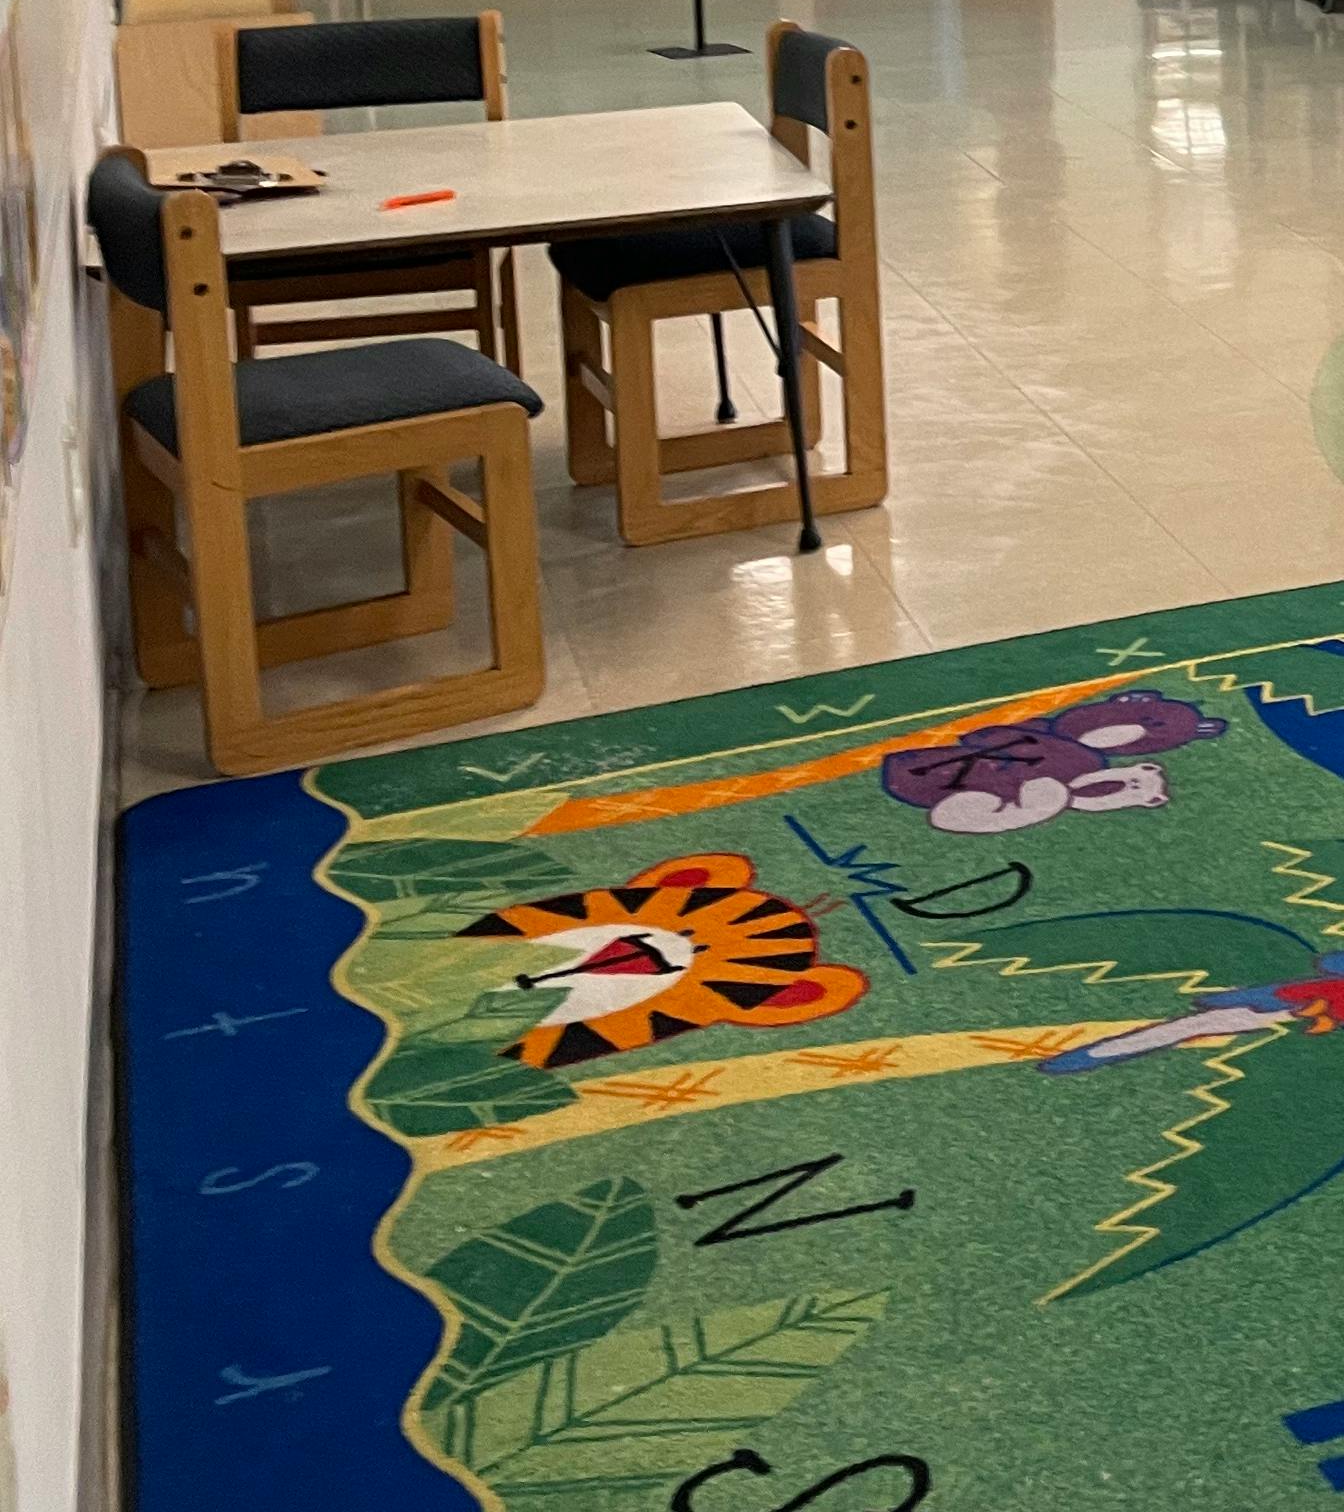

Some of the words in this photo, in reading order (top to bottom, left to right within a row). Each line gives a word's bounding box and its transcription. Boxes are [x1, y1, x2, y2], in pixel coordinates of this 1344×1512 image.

[774, 694, 875, 723] W
[1096, 638, 1165, 666] X
[890, 861, 1033, 919] D
